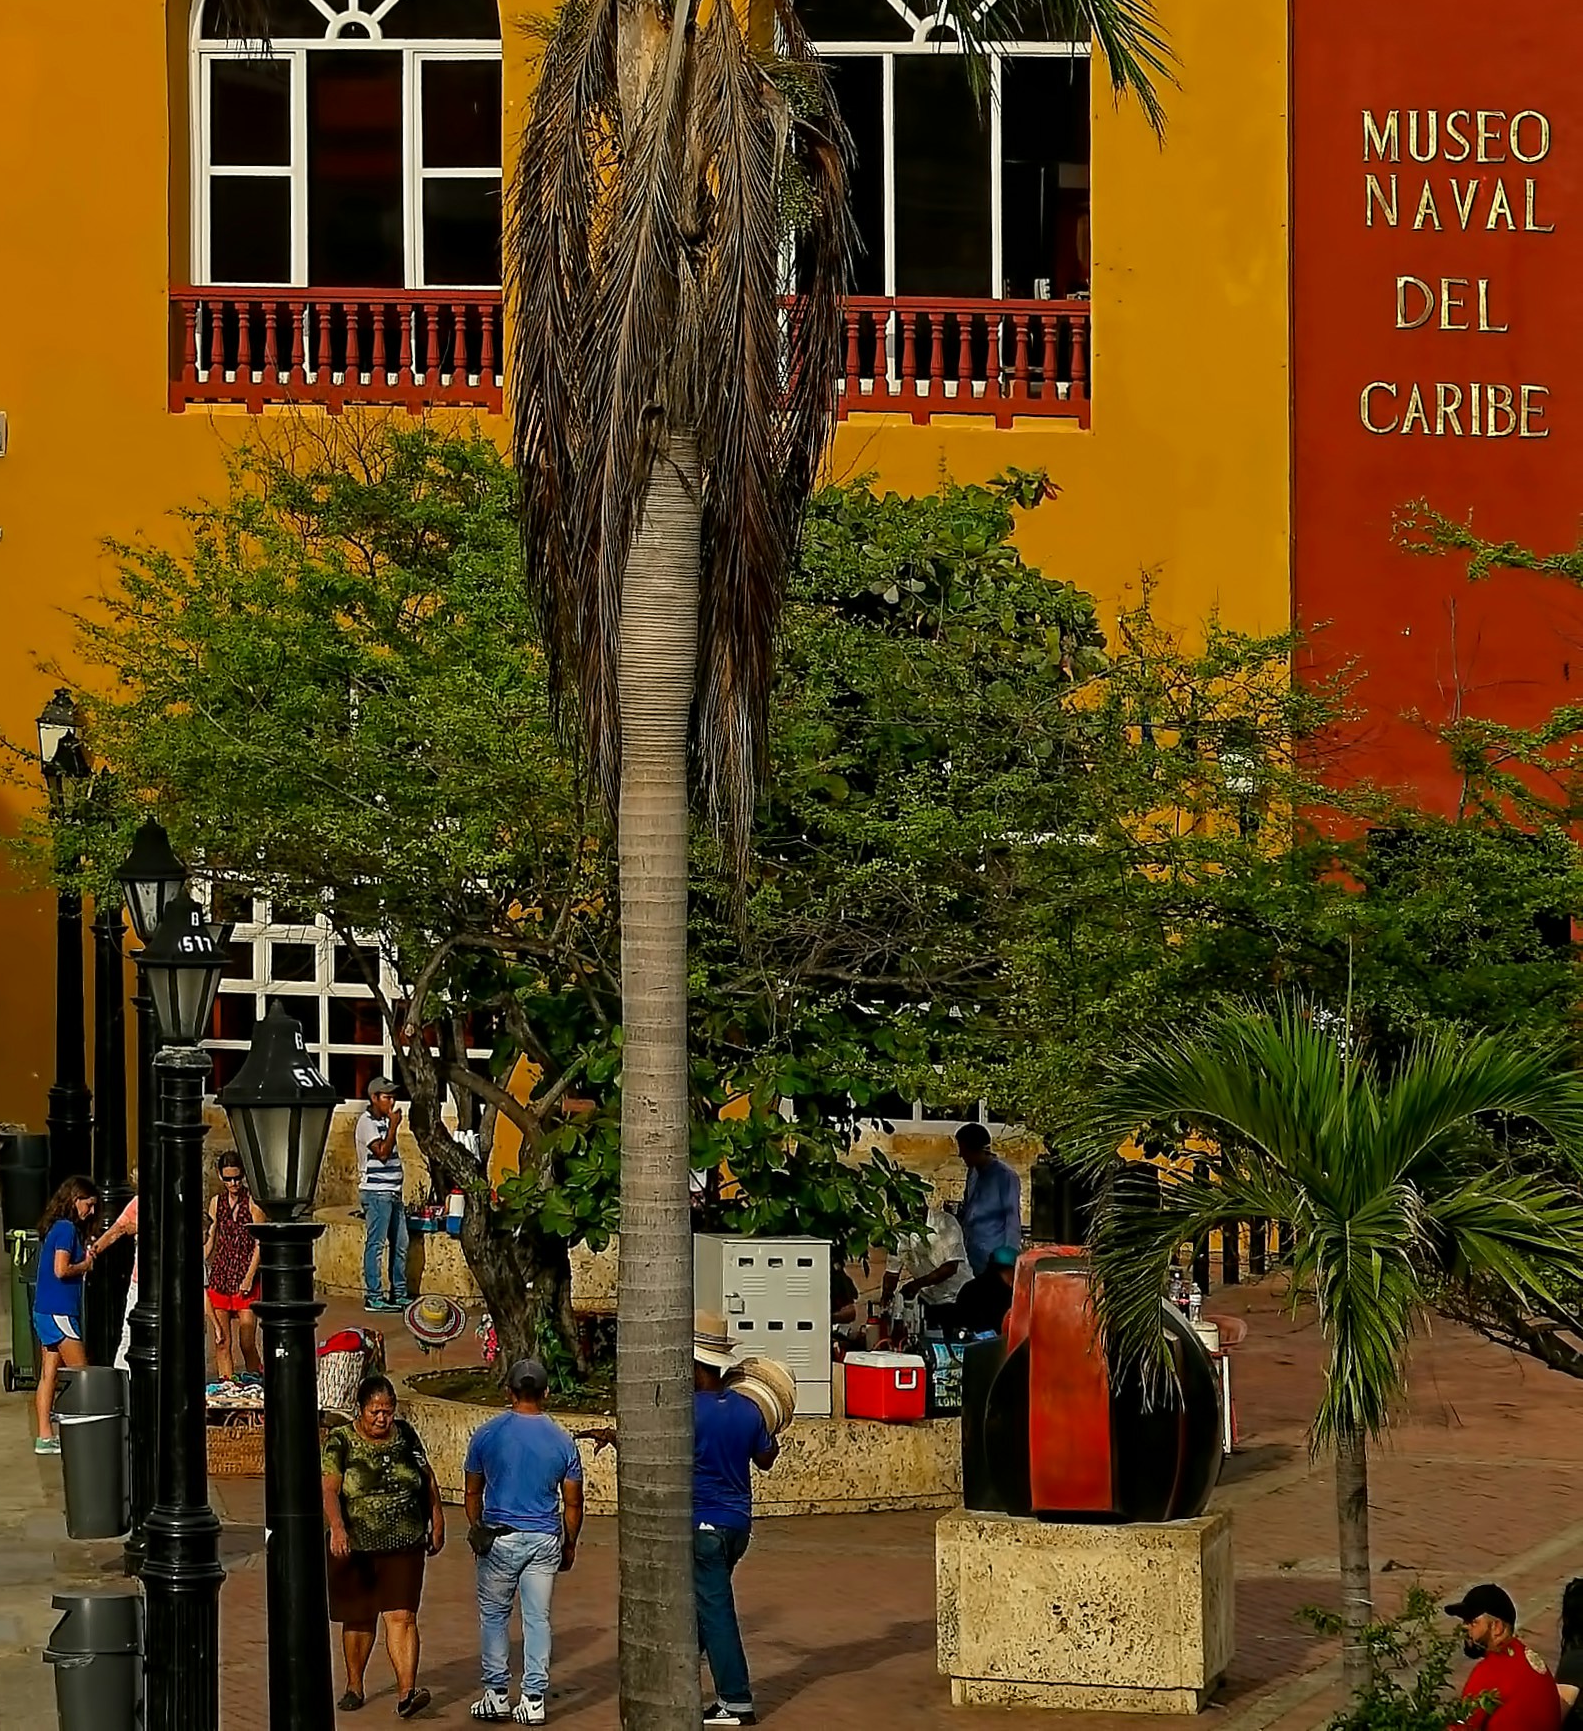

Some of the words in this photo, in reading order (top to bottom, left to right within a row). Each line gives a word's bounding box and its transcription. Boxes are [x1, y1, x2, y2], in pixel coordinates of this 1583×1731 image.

[1361, 110, 1551, 163] MUSEO
[1365, 173, 1555, 233] NAVAL
[1394, 275, 1509, 333] DEL
[1359, 380, 1550, 438] CARIBE
[191, 912, 200, 926] B
[295, 1032, 304, 1050] B
